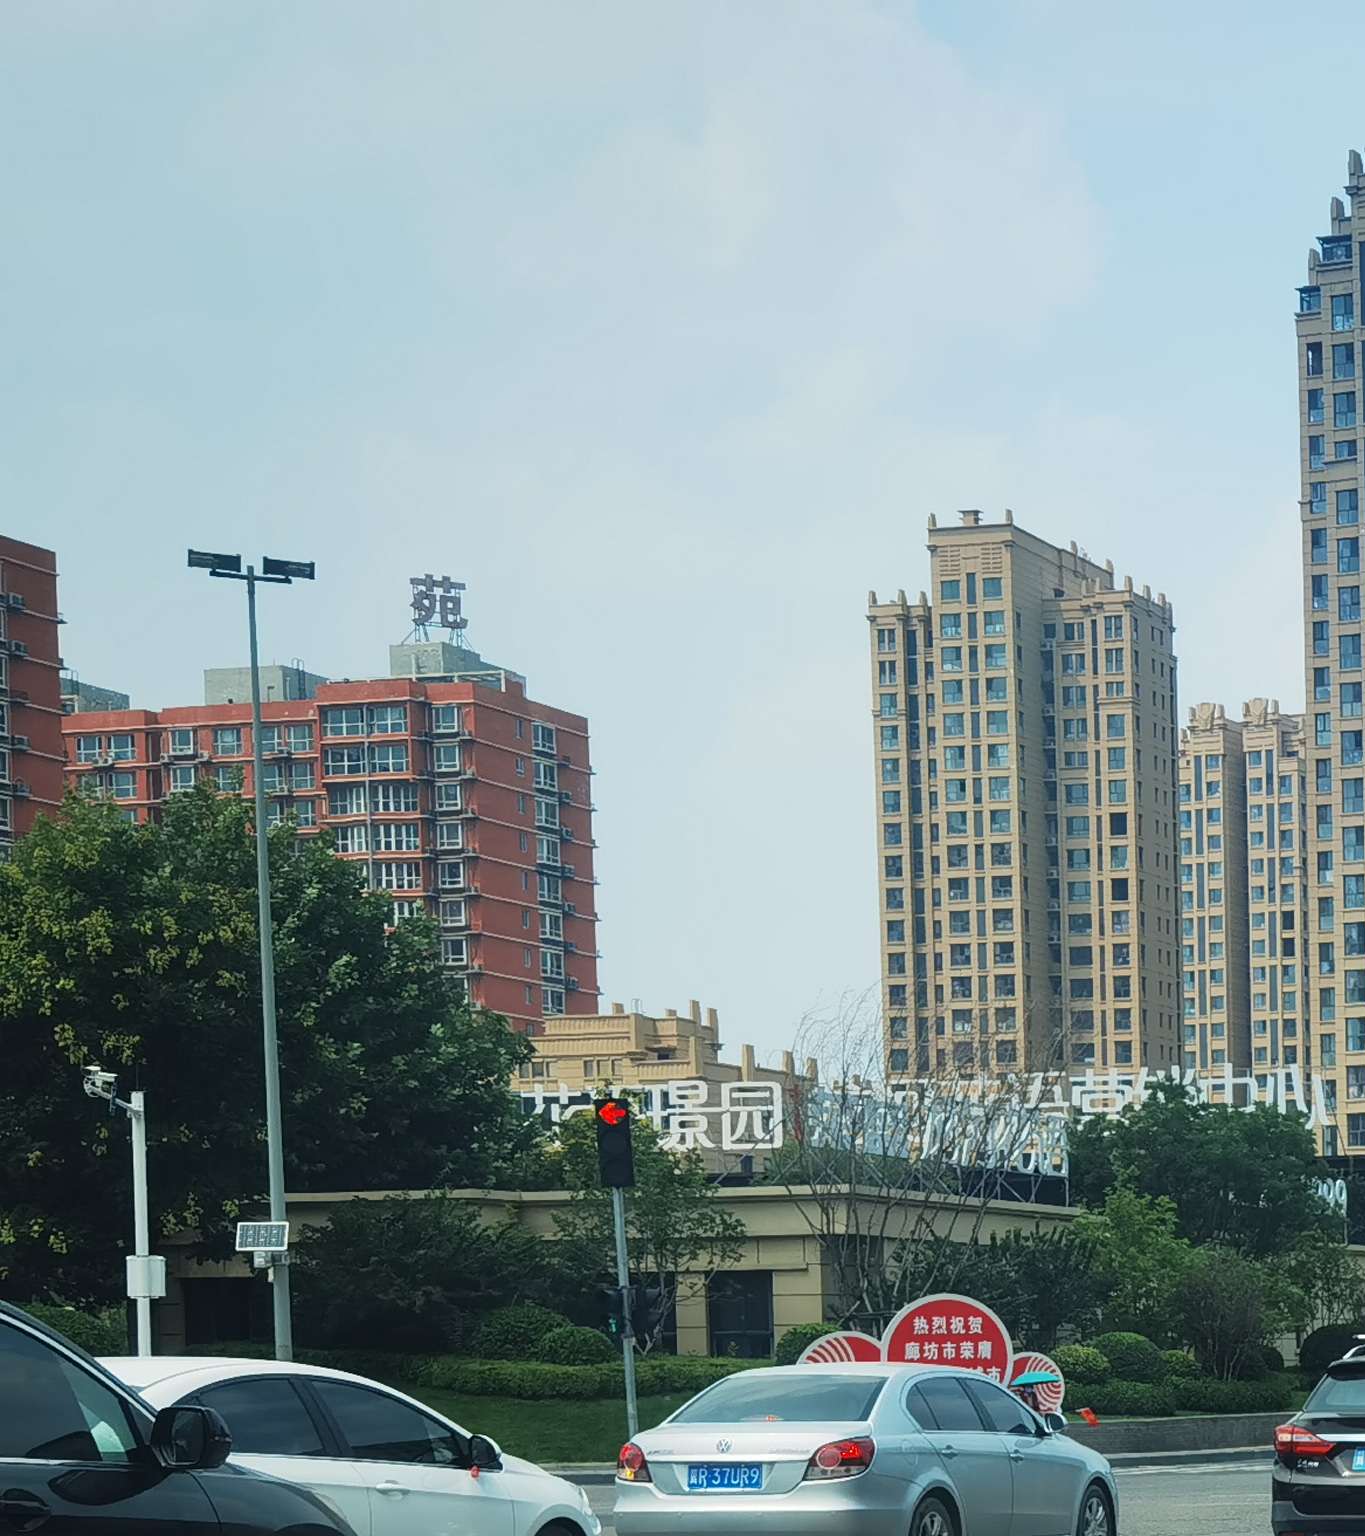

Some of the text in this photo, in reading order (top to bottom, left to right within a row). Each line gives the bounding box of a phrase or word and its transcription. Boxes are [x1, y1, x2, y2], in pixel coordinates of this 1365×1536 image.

[409, 573, 469, 629] 苑
[519, 1080, 783, 1151] 花璟园
[913, 1315, 983, 1335] 热烈祝贺
